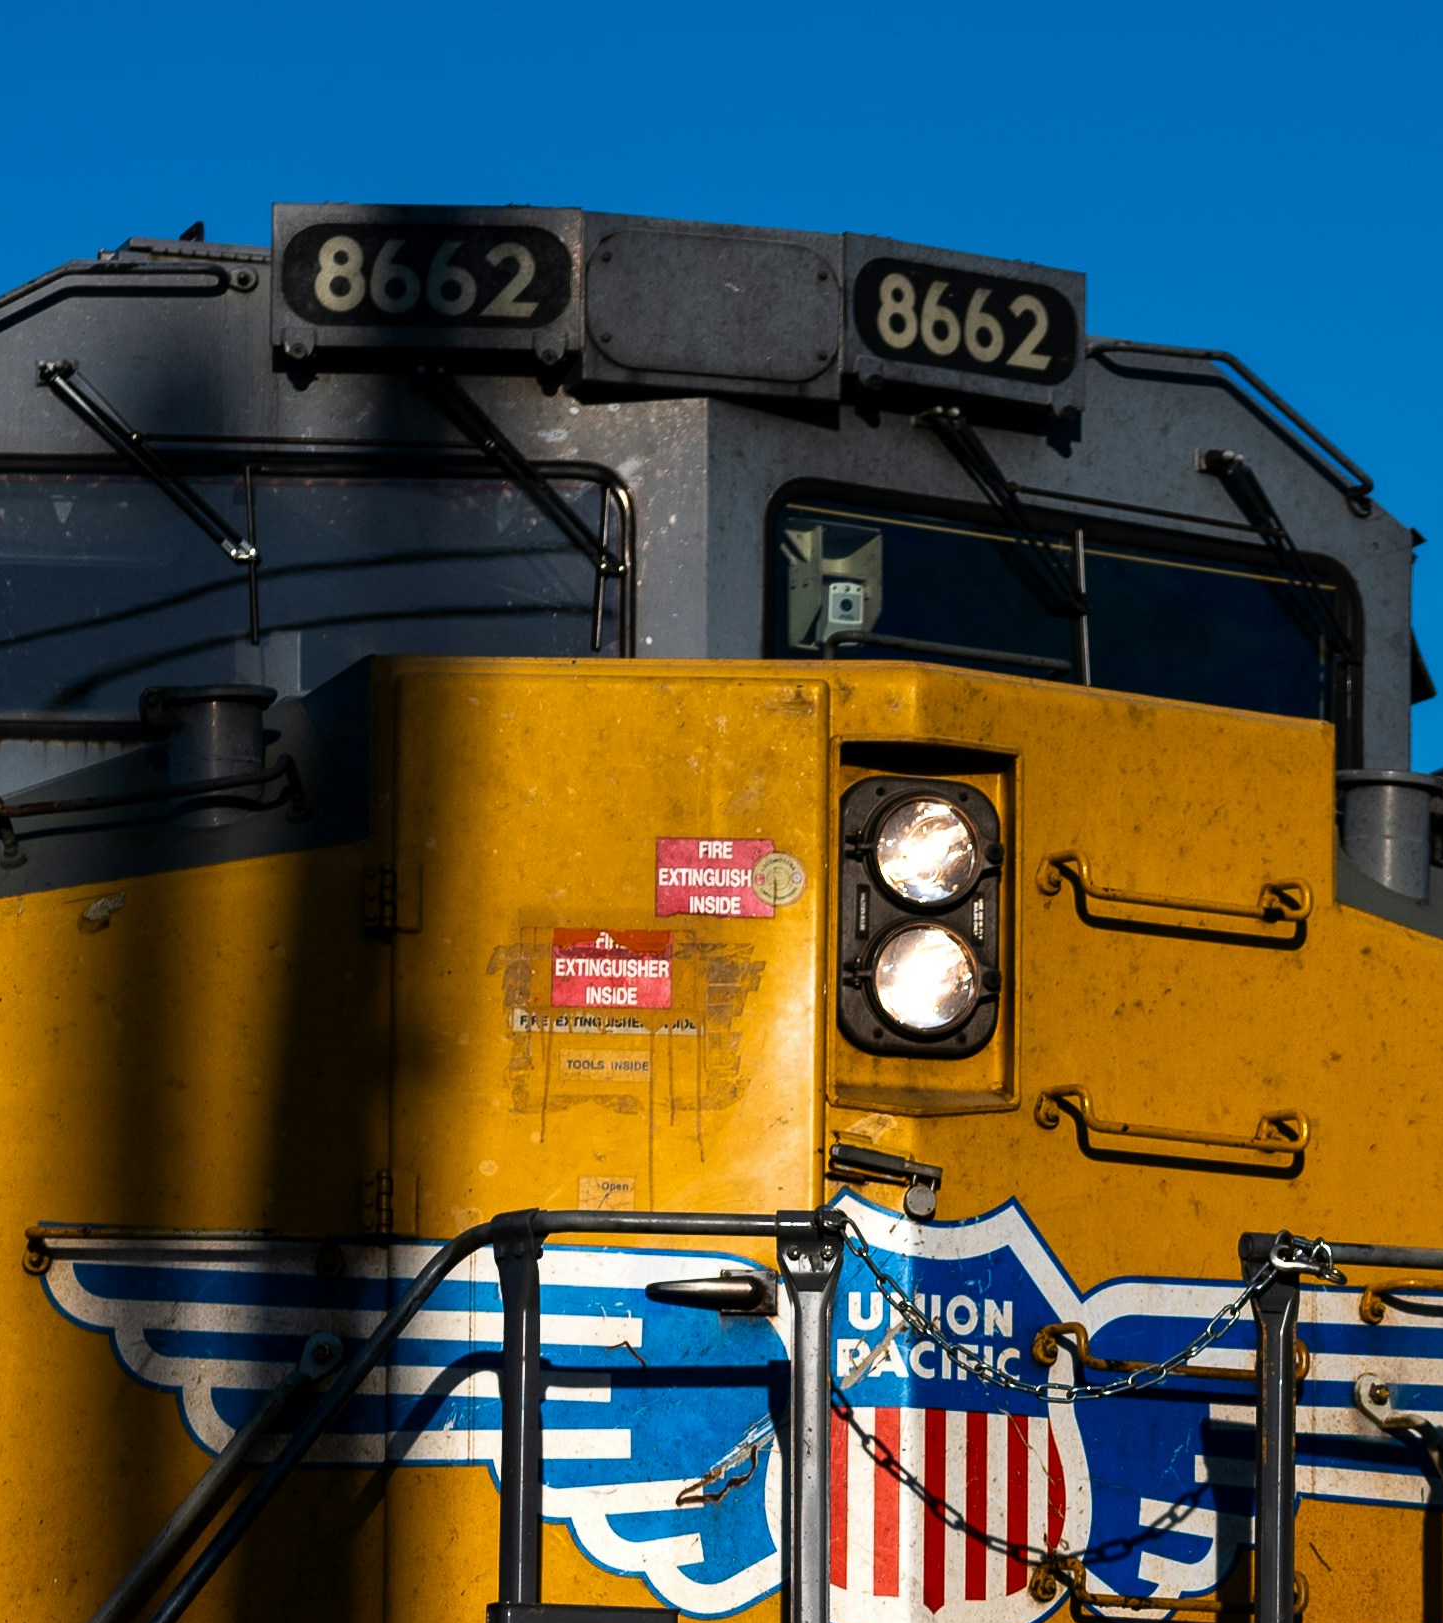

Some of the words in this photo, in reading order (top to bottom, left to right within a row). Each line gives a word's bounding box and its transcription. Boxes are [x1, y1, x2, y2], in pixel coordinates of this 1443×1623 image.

[314, 235, 540, 319] 8662
[876, 272, 1053, 371] 8662
[698, 840, 733, 860] FIRE
[658, 868, 752, 887] EXTINGUISH
[689, 896, 741, 915] INSIDE
[555, 959, 670, 979] EXTINGUISHER
[585, 986, 638, 1005] INSIDE
[566, 1060, 604, 1070] TOOLS
[611, 1060, 649, 1071] INSIDE
[601, 1181, 629, 1191] Open
[848, 1291, 1014, 1338] UNION
